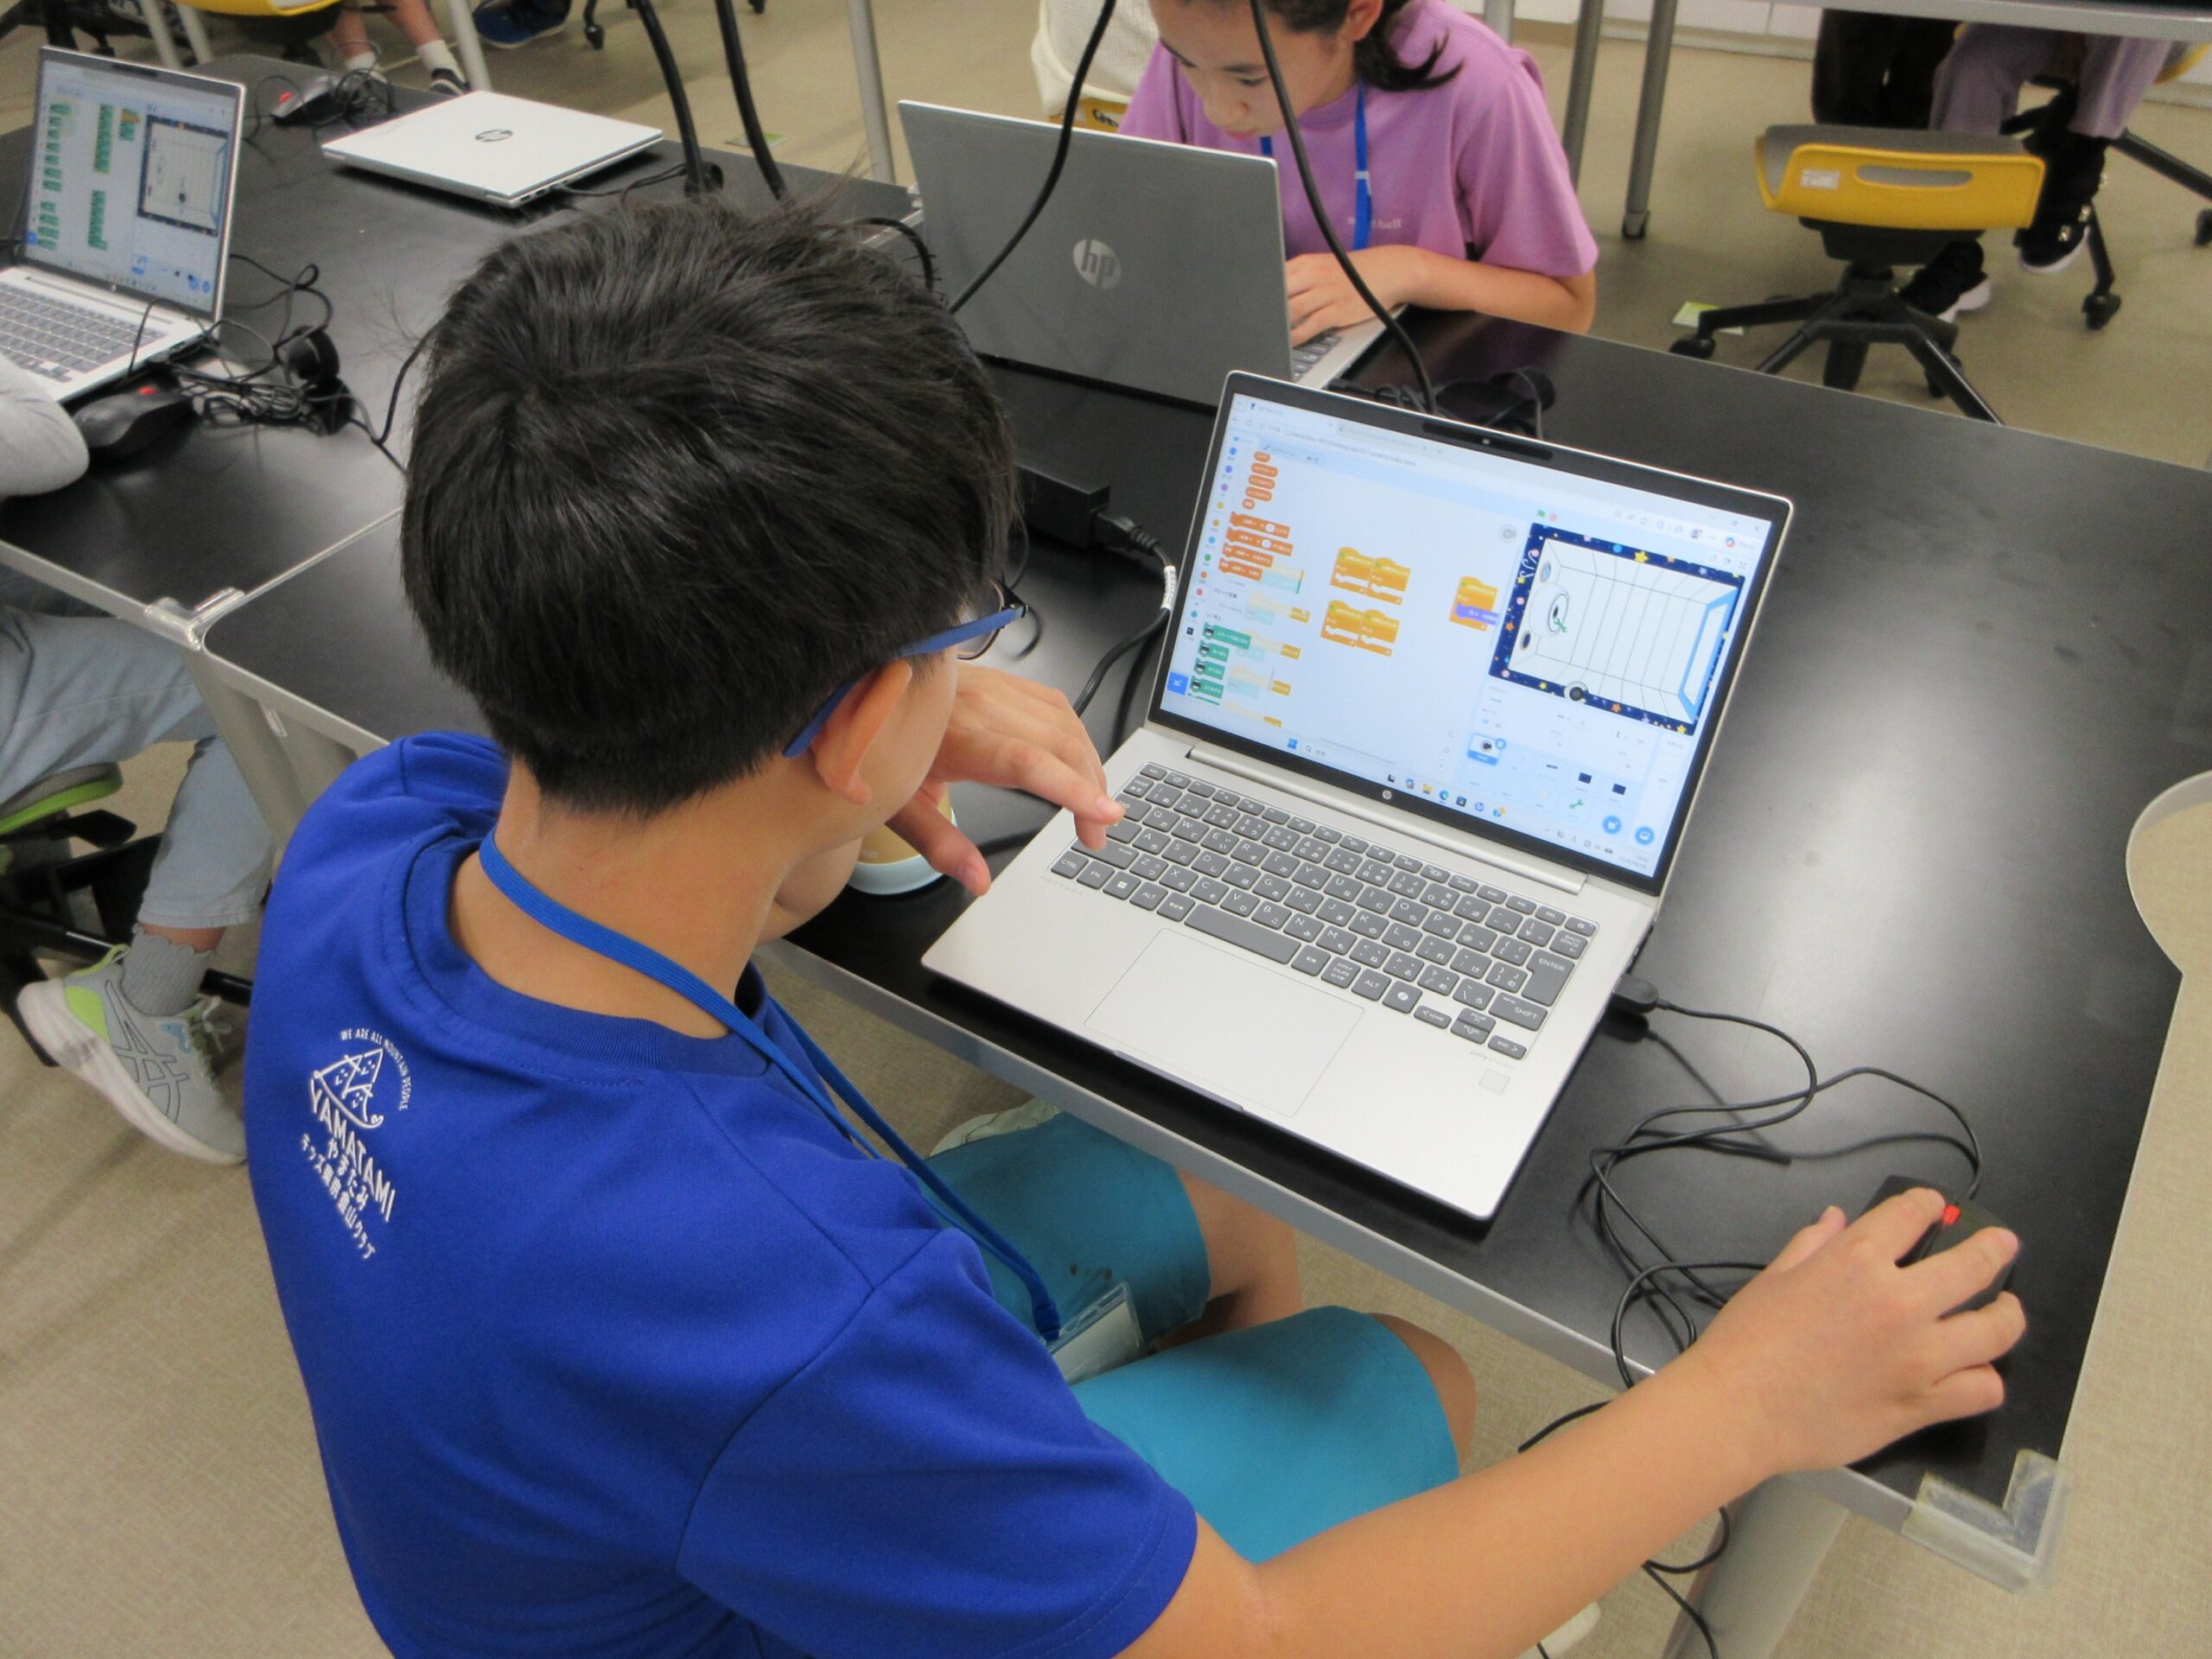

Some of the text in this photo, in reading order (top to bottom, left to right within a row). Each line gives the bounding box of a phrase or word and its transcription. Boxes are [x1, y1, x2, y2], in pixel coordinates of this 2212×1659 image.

[1072, 238, 1122, 289] hp
[1061, 860, 1077, 868] CTRL
[1170, 868, 1179, 877] X
[1539, 958, 1566, 971] ENTER
[1364, 980, 1379, 988] ALT
[1514, 1007, 1538, 1019] SHIFT
[341, 1028, 353, 1040] WE
[371, 1031, 383, 1045] ALL
[384, 1039, 409, 1077] MOUNTAIN
[398, 1077, 411, 1111] PEOPLE
[311, 1078, 396, 1223] YAMATAMI
[328, 1137, 370, 1211] やまたみ
